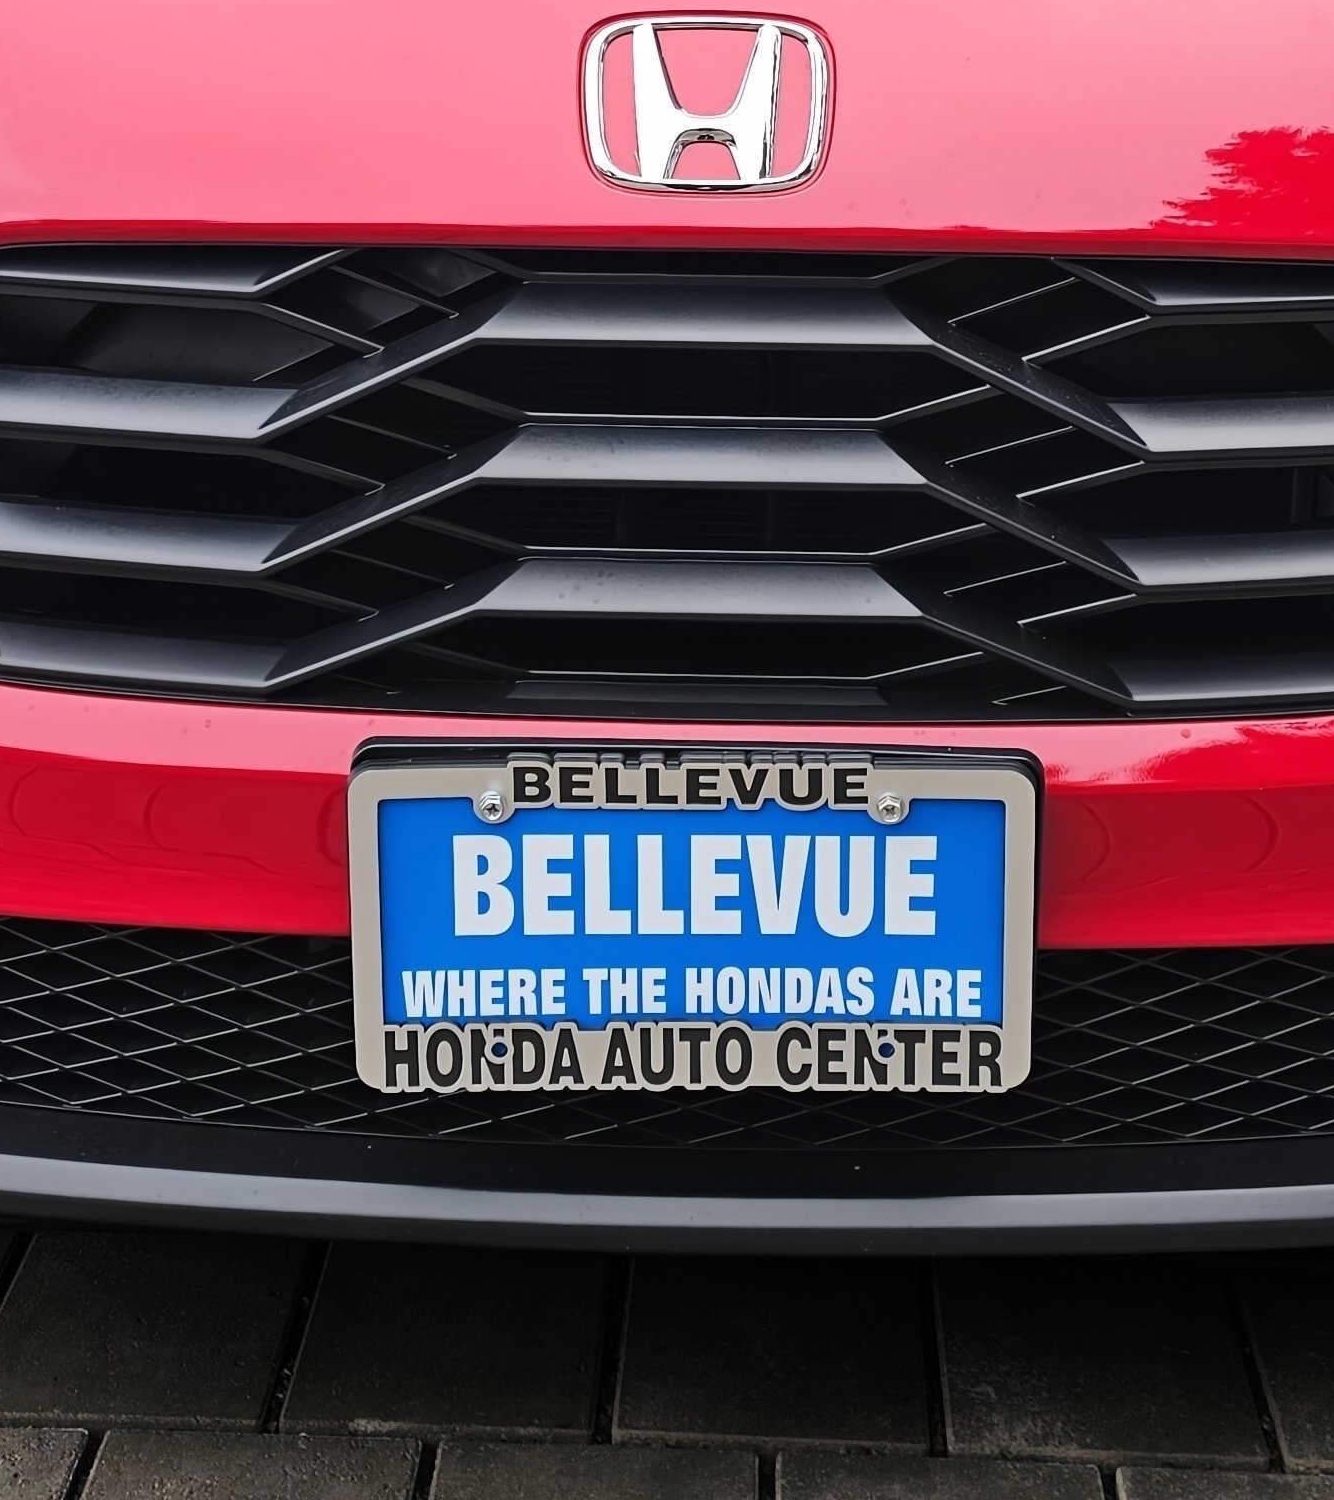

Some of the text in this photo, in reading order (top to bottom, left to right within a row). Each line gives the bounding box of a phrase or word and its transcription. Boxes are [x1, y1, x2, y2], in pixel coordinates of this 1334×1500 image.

[512, 766, 869, 806] BELLEVUE
[452, 833, 939, 938] BELLEVUE
[401, 966, 982, 1018] WHERE THE HONDAS ARE
[384, 1026, 1003, 1088] HONDA AUTO CENTER
